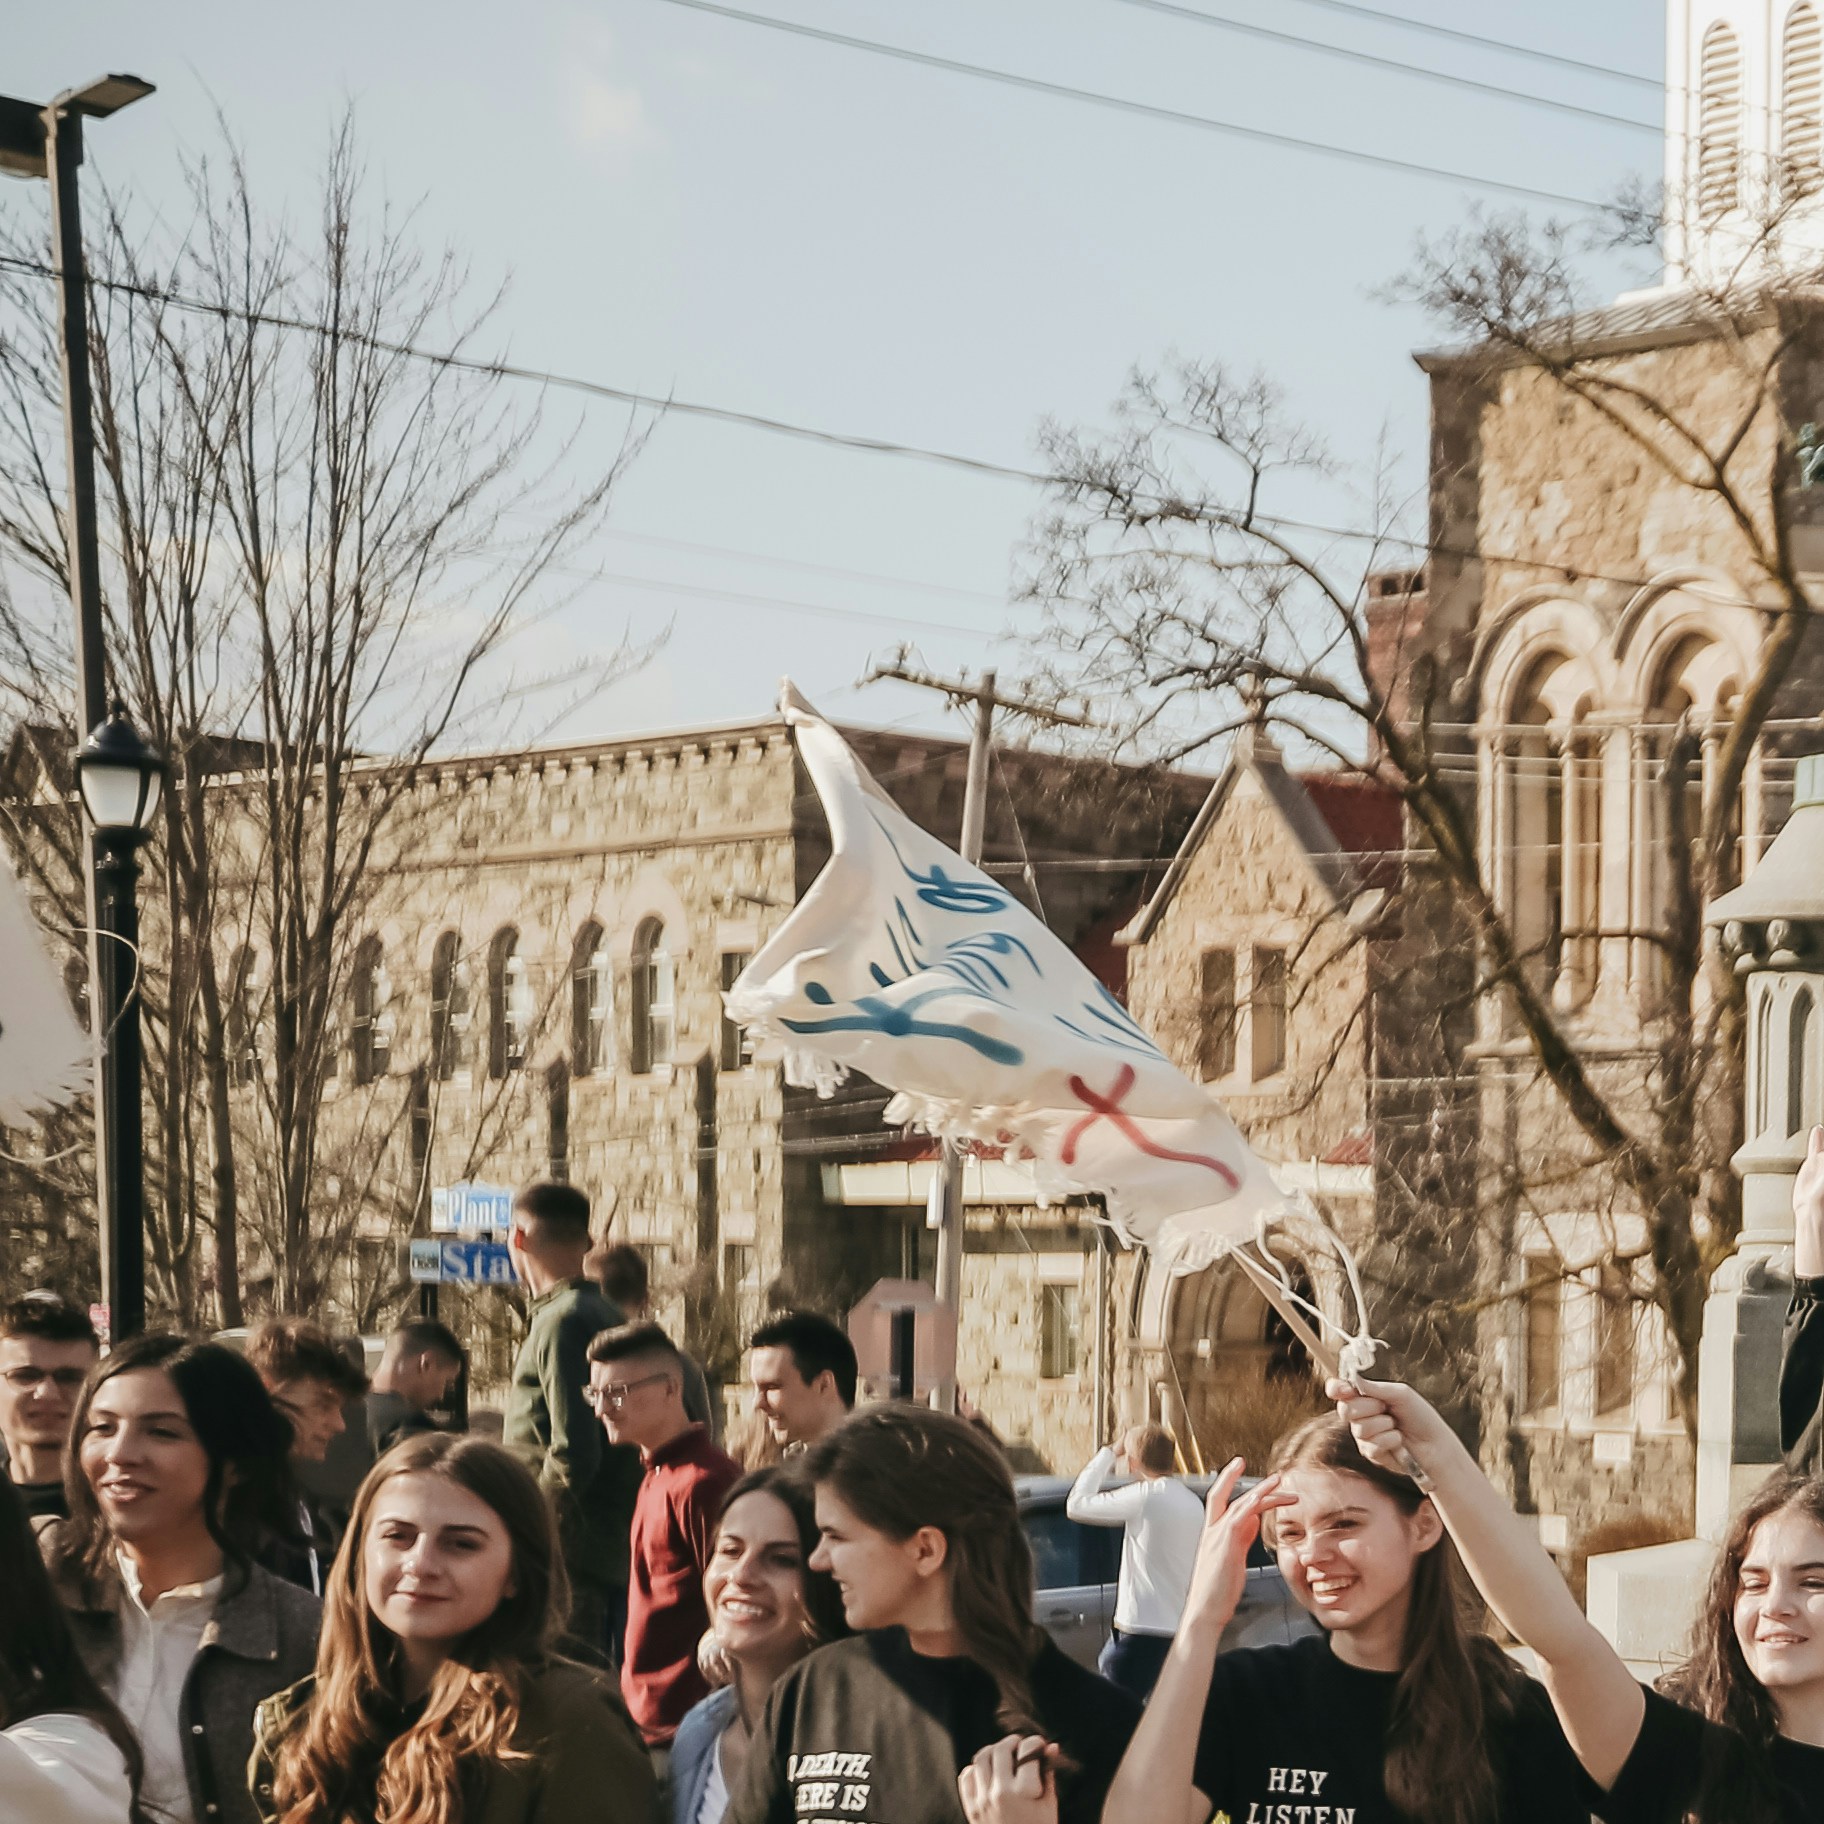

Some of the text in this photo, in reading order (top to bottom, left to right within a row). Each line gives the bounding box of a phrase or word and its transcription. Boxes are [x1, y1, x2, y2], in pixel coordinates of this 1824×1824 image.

[442, 1246, 511, 1281] Sta
[1267, 1767, 1329, 1796] HEY
[840, 1784, 871, 1811] IS
